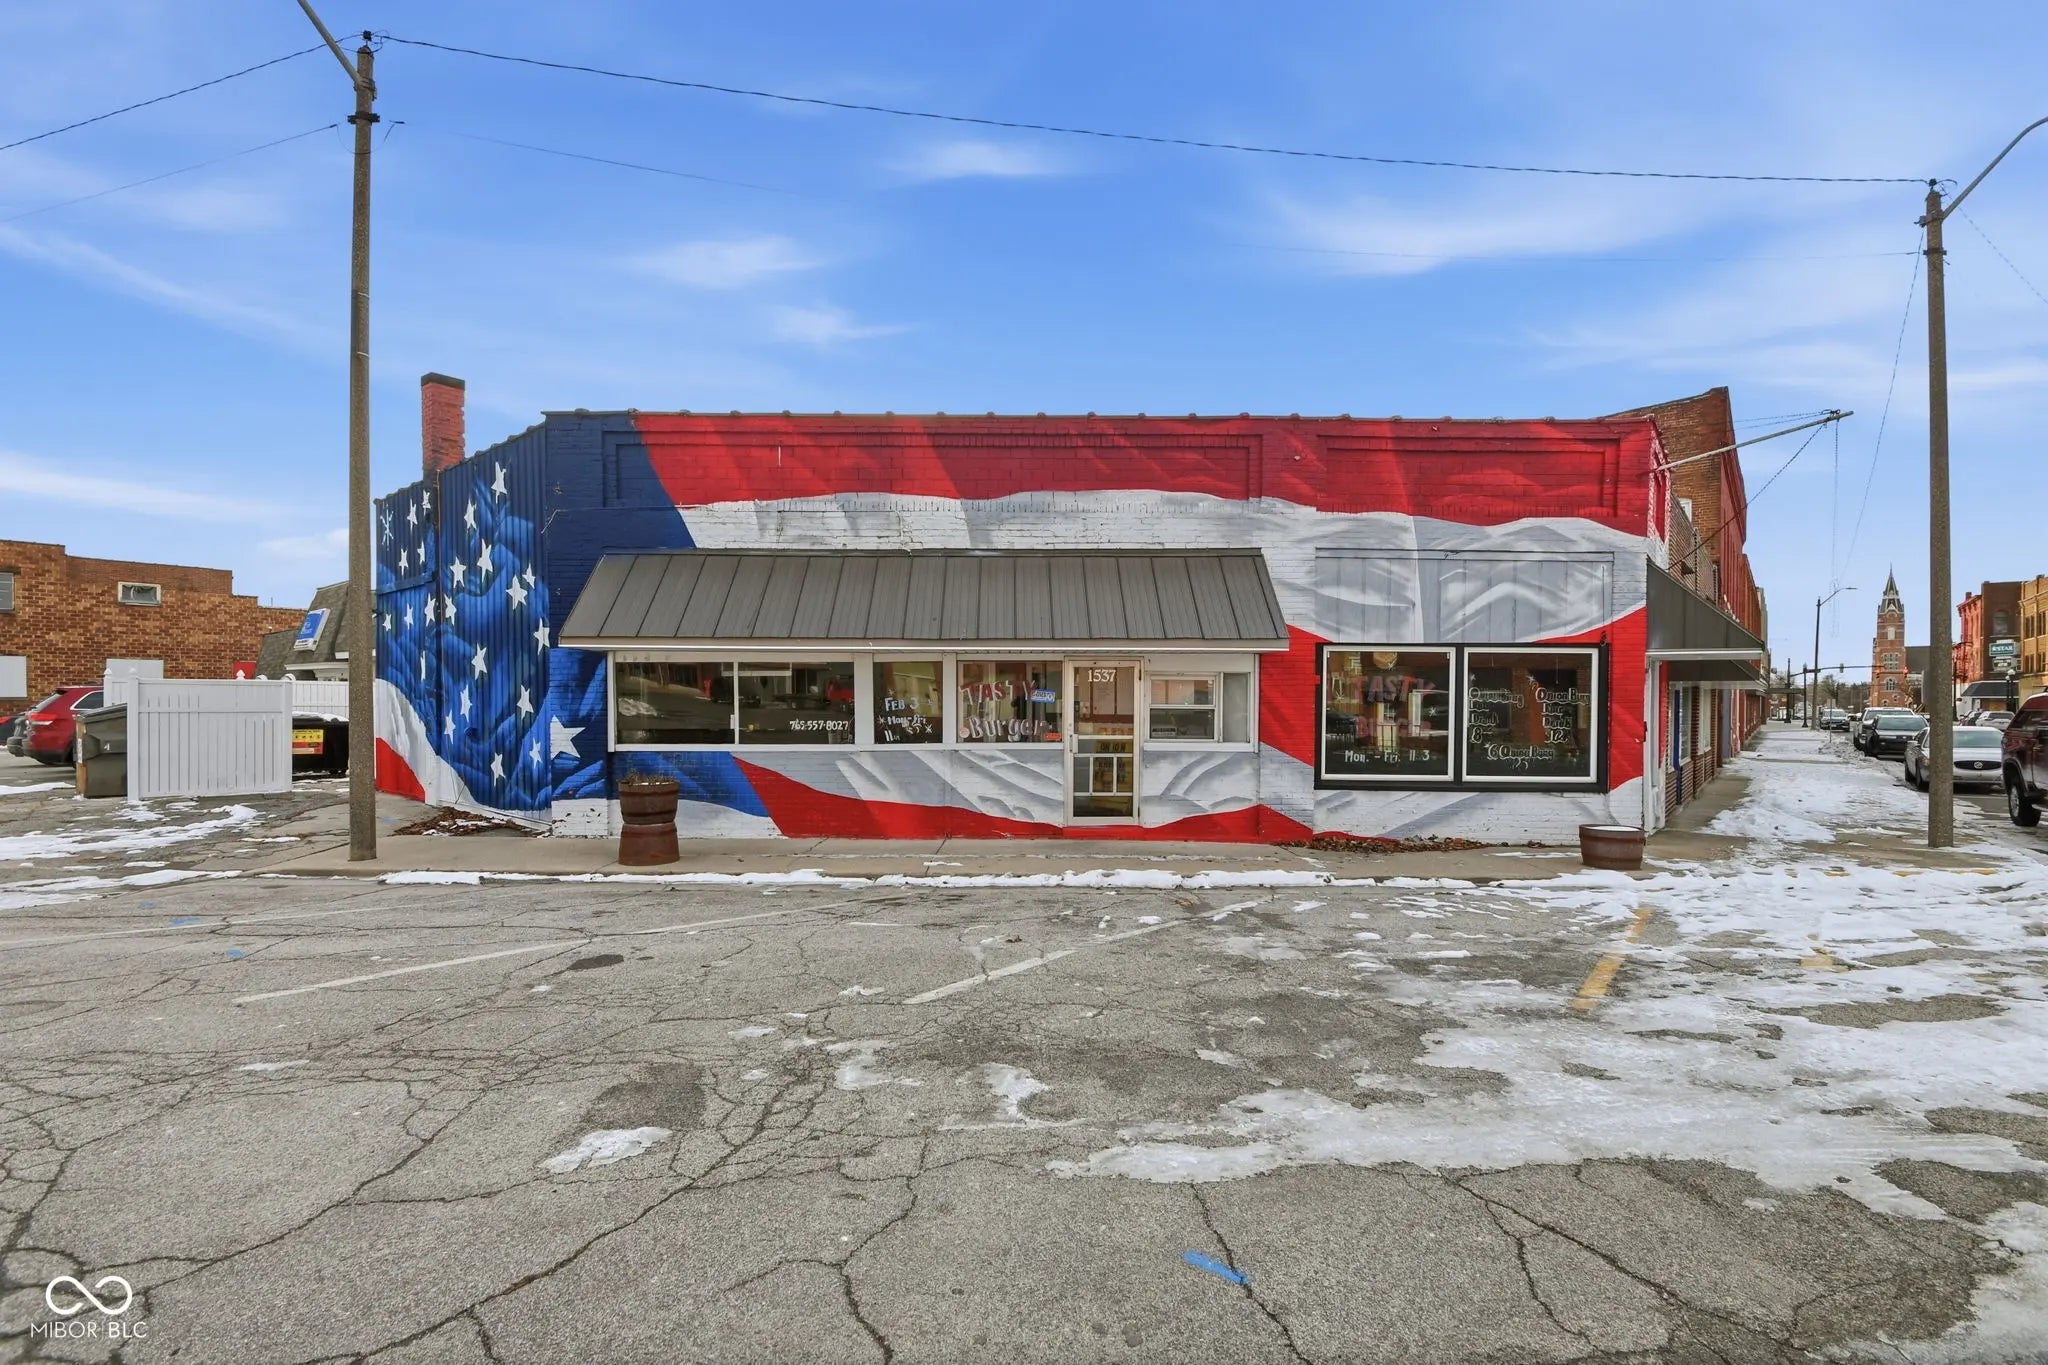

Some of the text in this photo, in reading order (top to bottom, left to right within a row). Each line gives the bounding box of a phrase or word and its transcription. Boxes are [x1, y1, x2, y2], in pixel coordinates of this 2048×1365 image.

[1088, 669, 1117, 682] 1537
[959, 680, 1035, 705] TASTY
[968, 716, 1050, 742] Burger
[1344, 750, 1370, 762] Mon.
